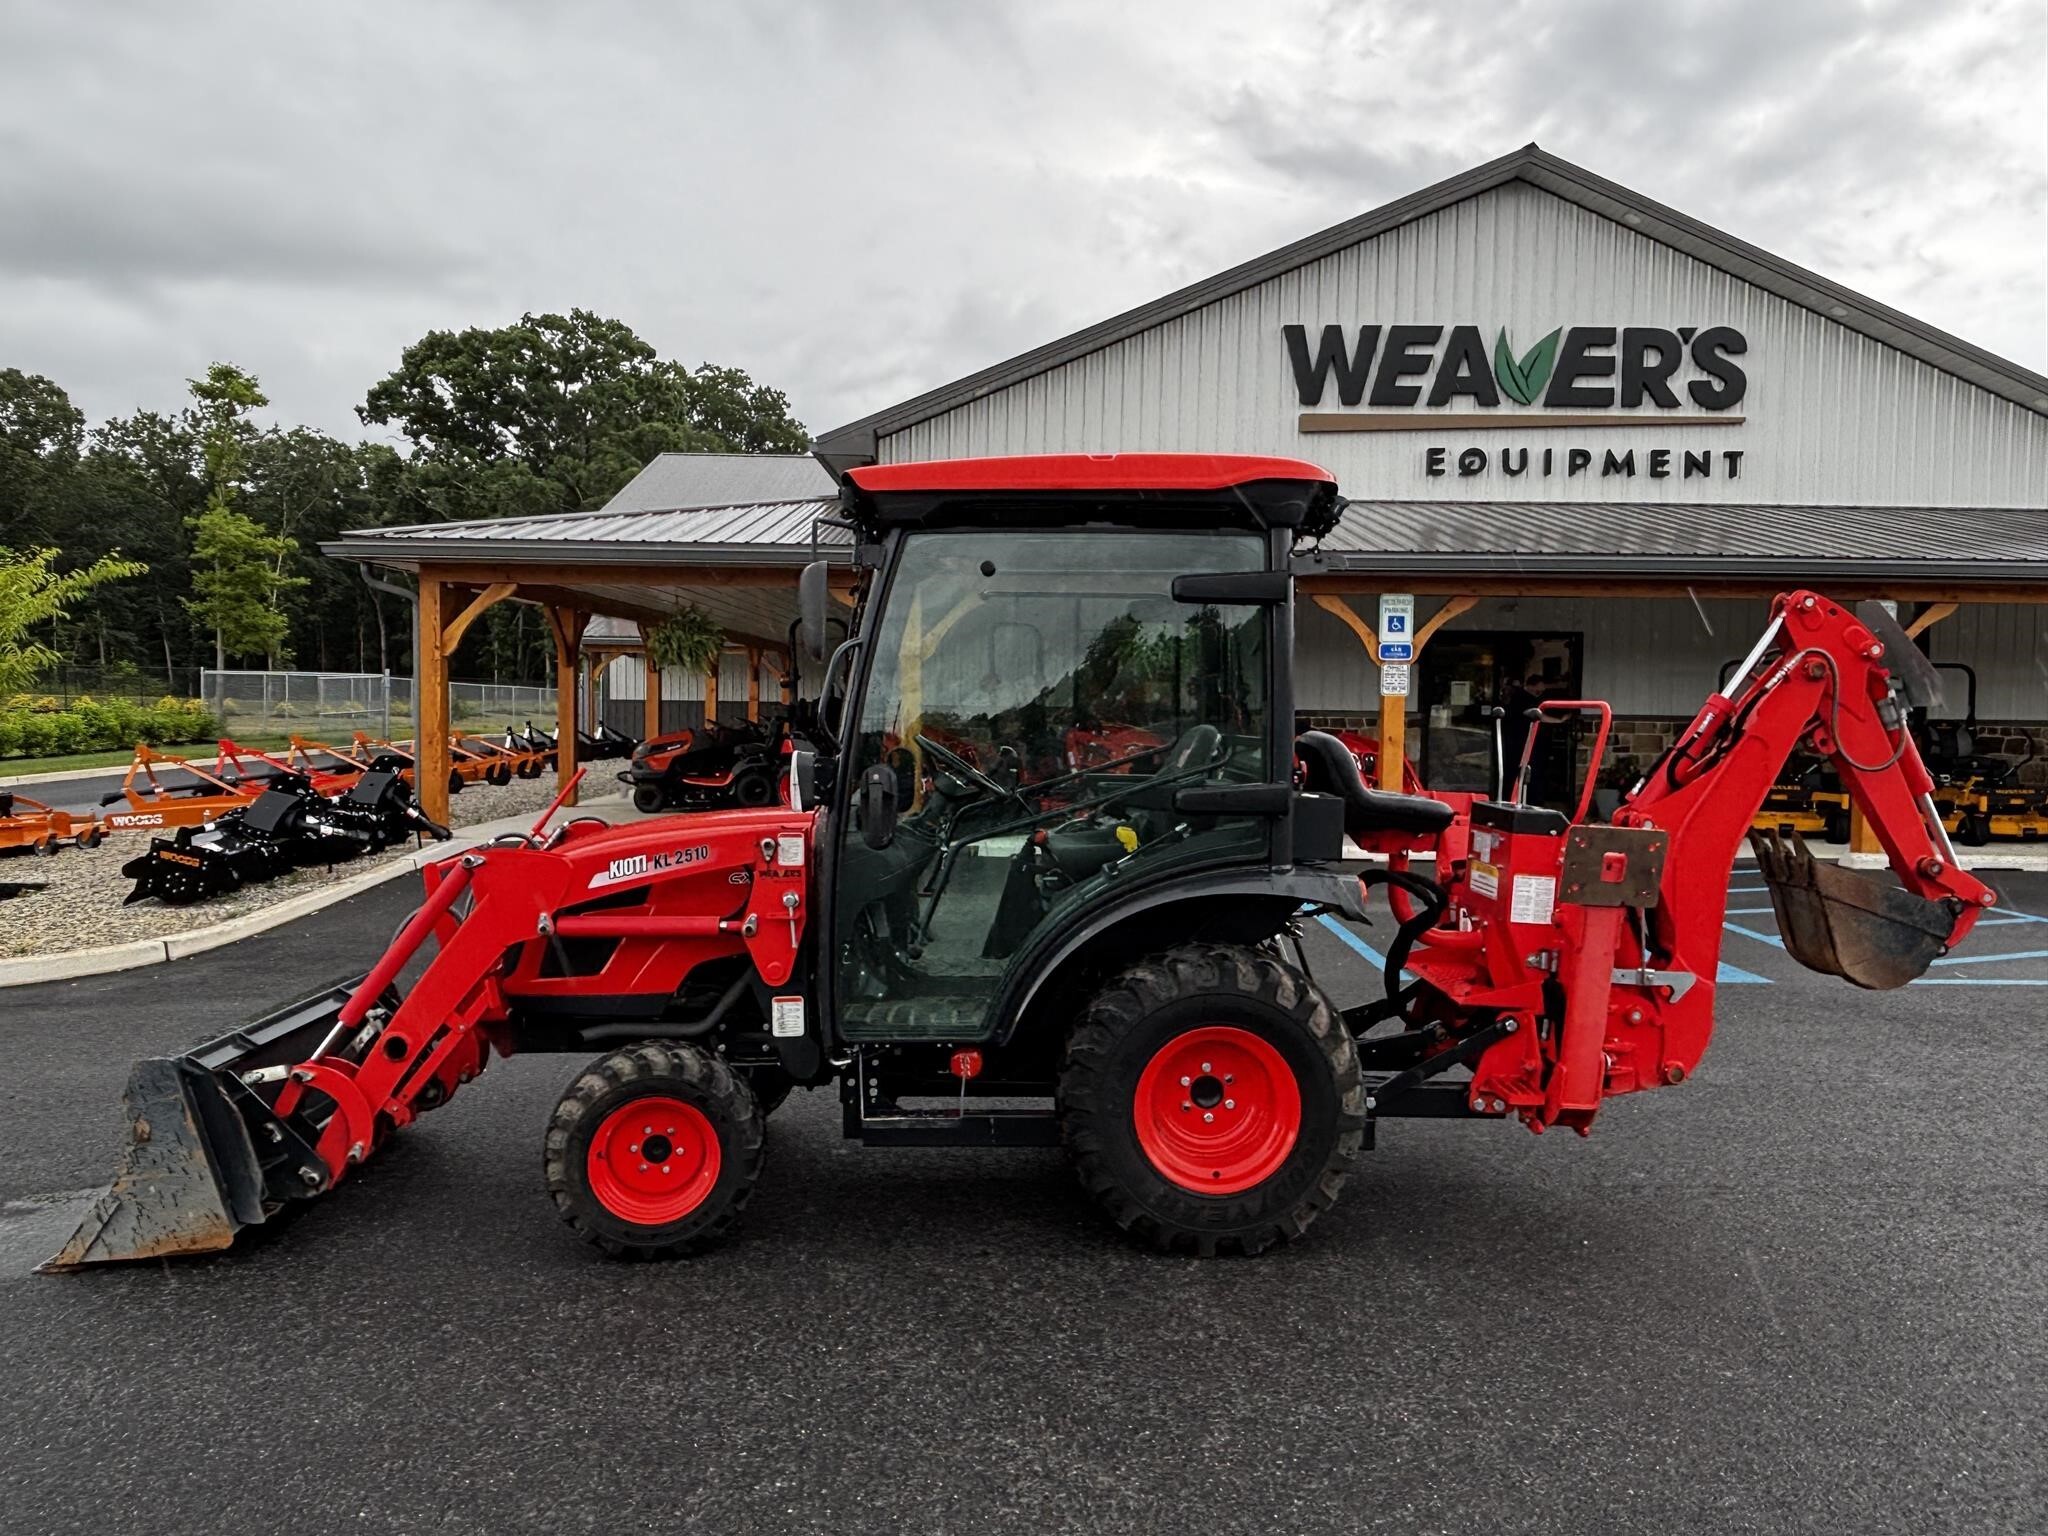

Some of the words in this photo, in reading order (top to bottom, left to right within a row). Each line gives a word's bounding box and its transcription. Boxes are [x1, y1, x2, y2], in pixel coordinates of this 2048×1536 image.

[1282, 324, 1748, 410] WEAVER'S
[1426, 447, 1745, 479] EQUIPMENT
[112, 814, 163, 826] WOODS
[609, 855, 647, 879] KIOTI
[653, 853, 672, 870] KL
[675, 845, 709, 866] 2510
